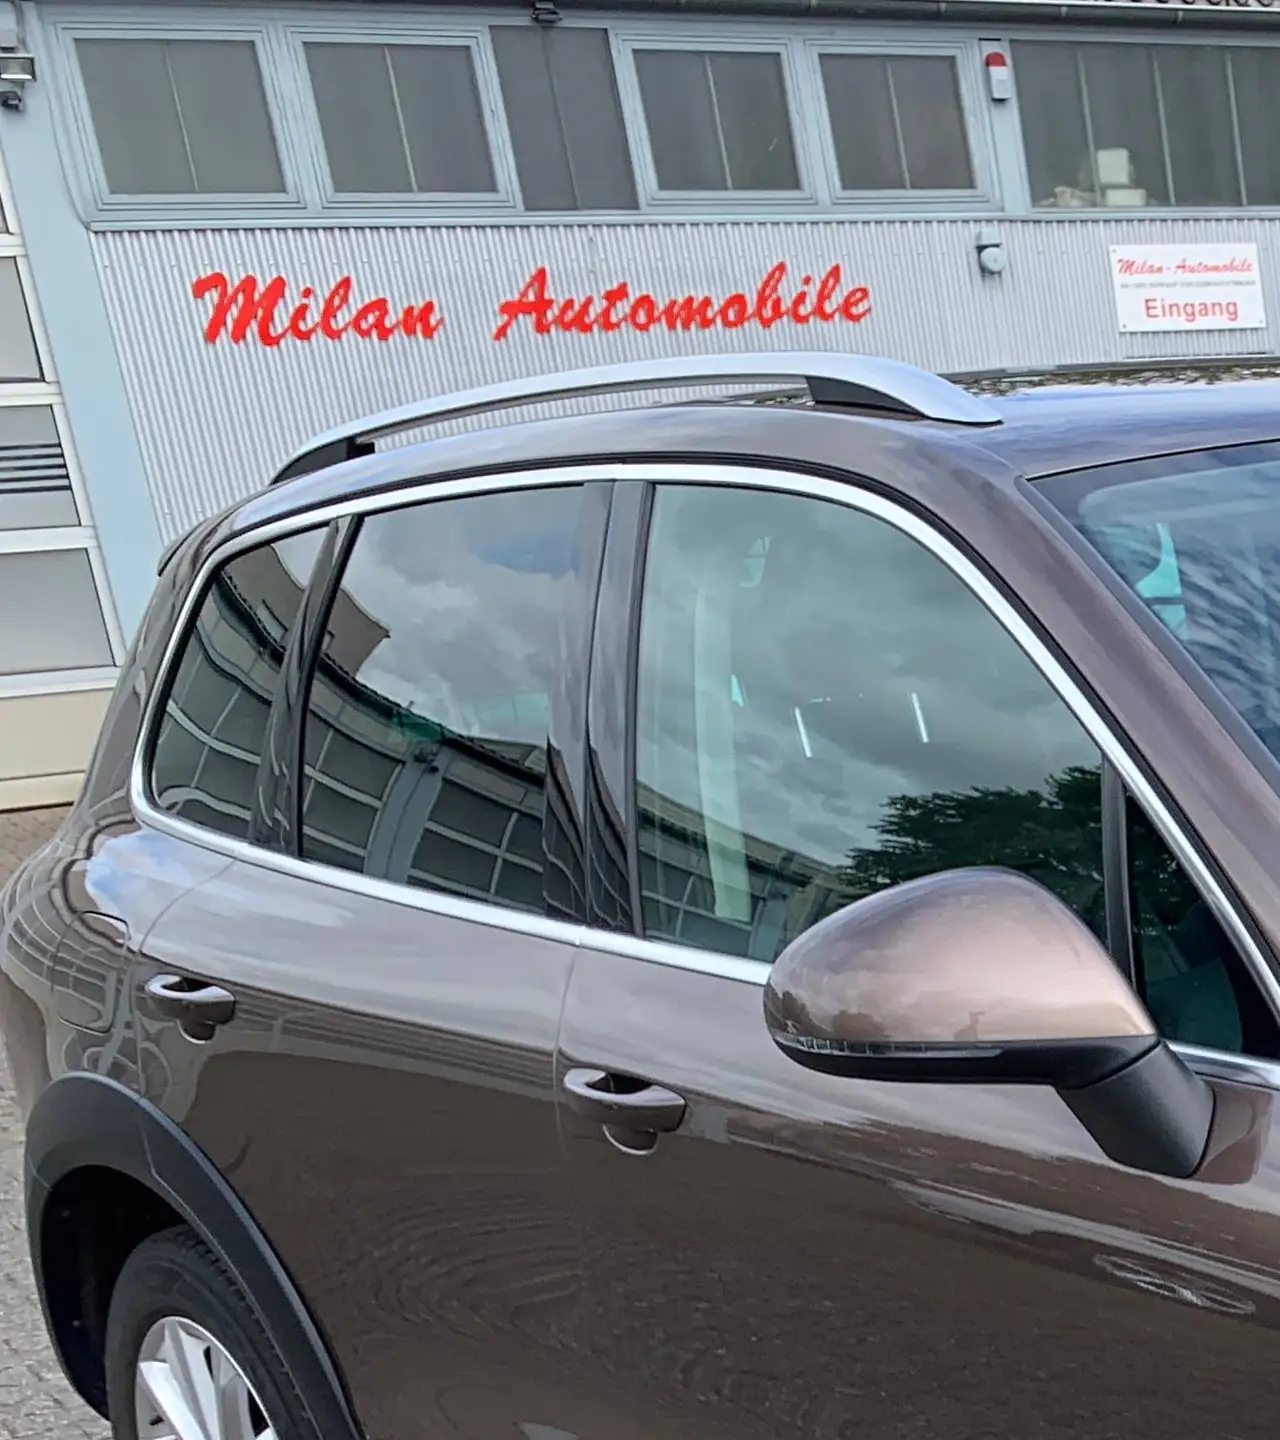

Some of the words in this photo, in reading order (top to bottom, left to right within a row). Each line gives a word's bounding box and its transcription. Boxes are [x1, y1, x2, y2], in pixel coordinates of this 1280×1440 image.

[192, 272, 444, 347] Milan
[493, 261, 871, 341] Automobile
[1144, 298, 1239, 322] Eingang
